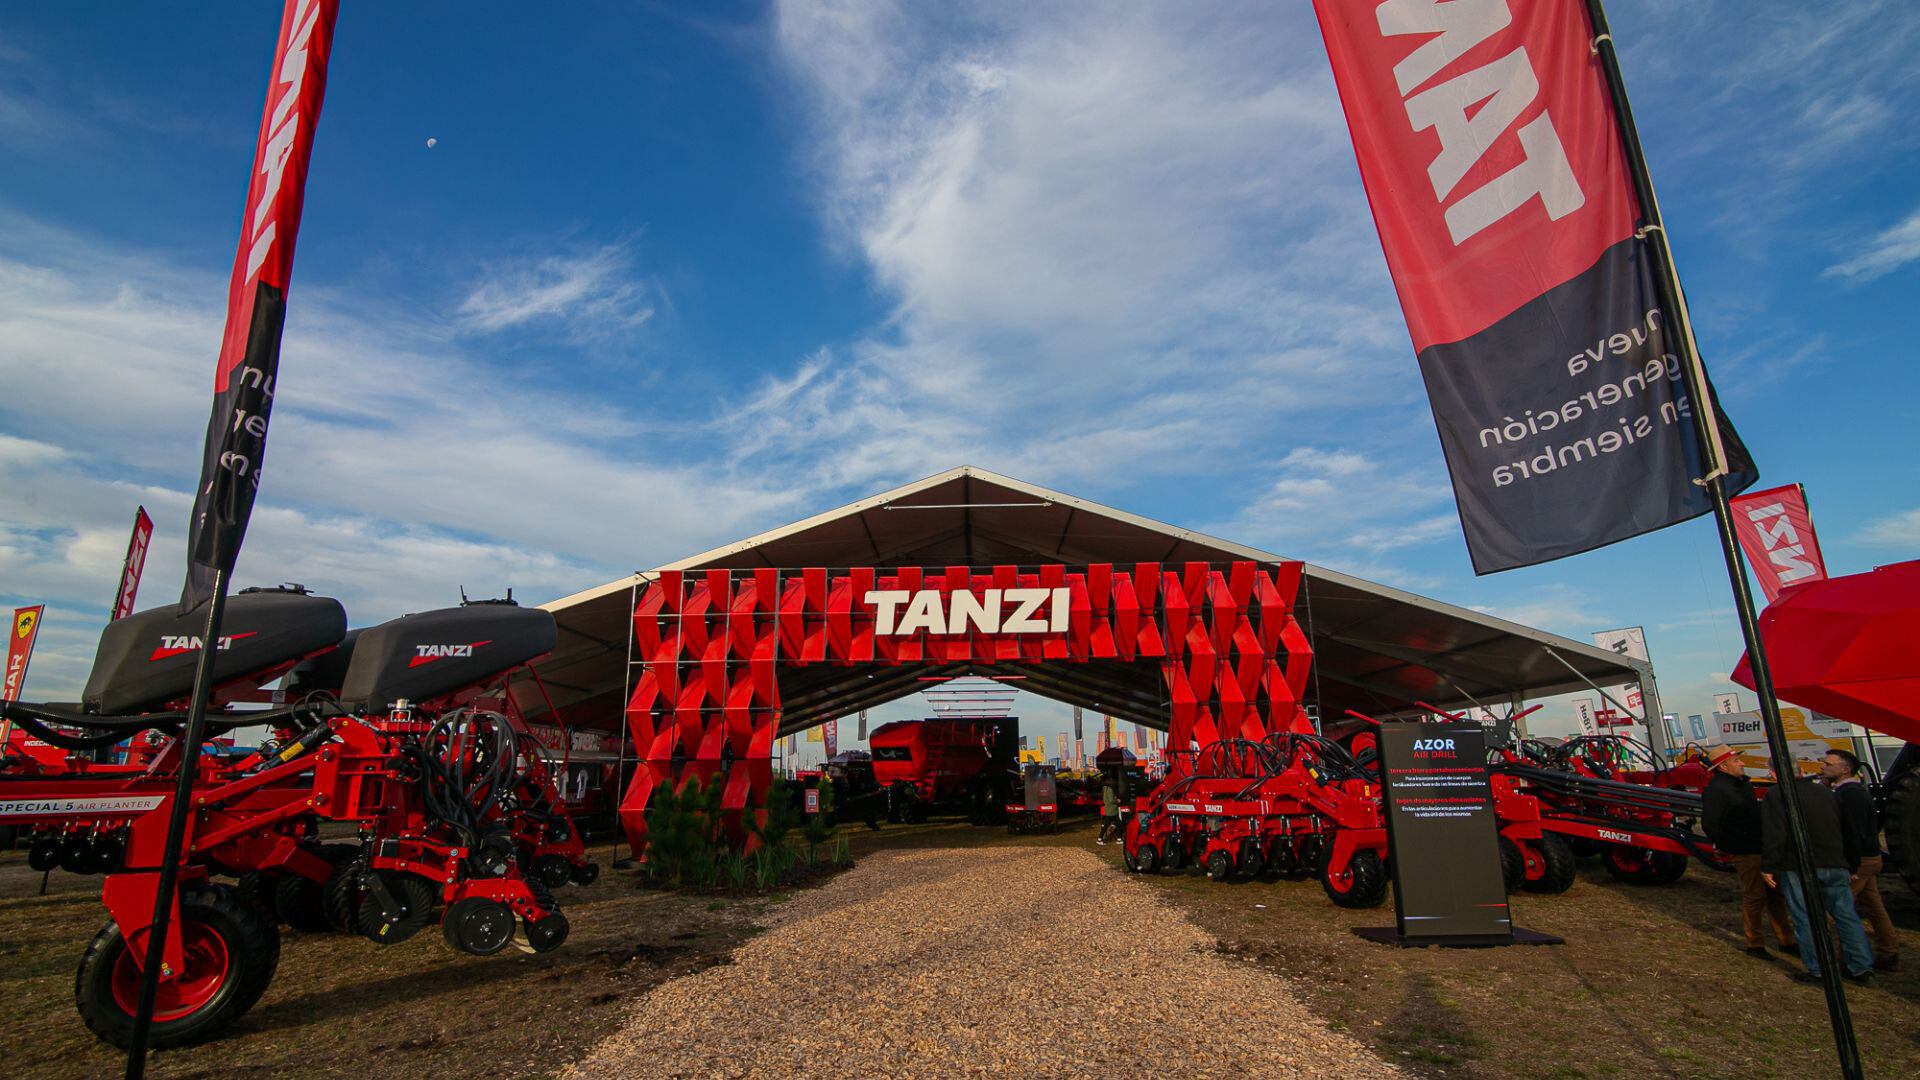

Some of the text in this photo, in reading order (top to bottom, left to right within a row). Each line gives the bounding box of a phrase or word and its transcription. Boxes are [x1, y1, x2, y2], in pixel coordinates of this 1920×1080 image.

[864, 587, 1071, 636] TANZI
[416, 644, 473, 657] TANZI
[1731, 720, 1761, 733] TBeH
[1413, 739, 1456, 751] AZOR
[1413, 751, 1457, 759] AIR DRILL
[0, 800, 152, 812] SPECIAL 5 AIR PLANTER
[1598, 829, 1632, 843] TANZI
